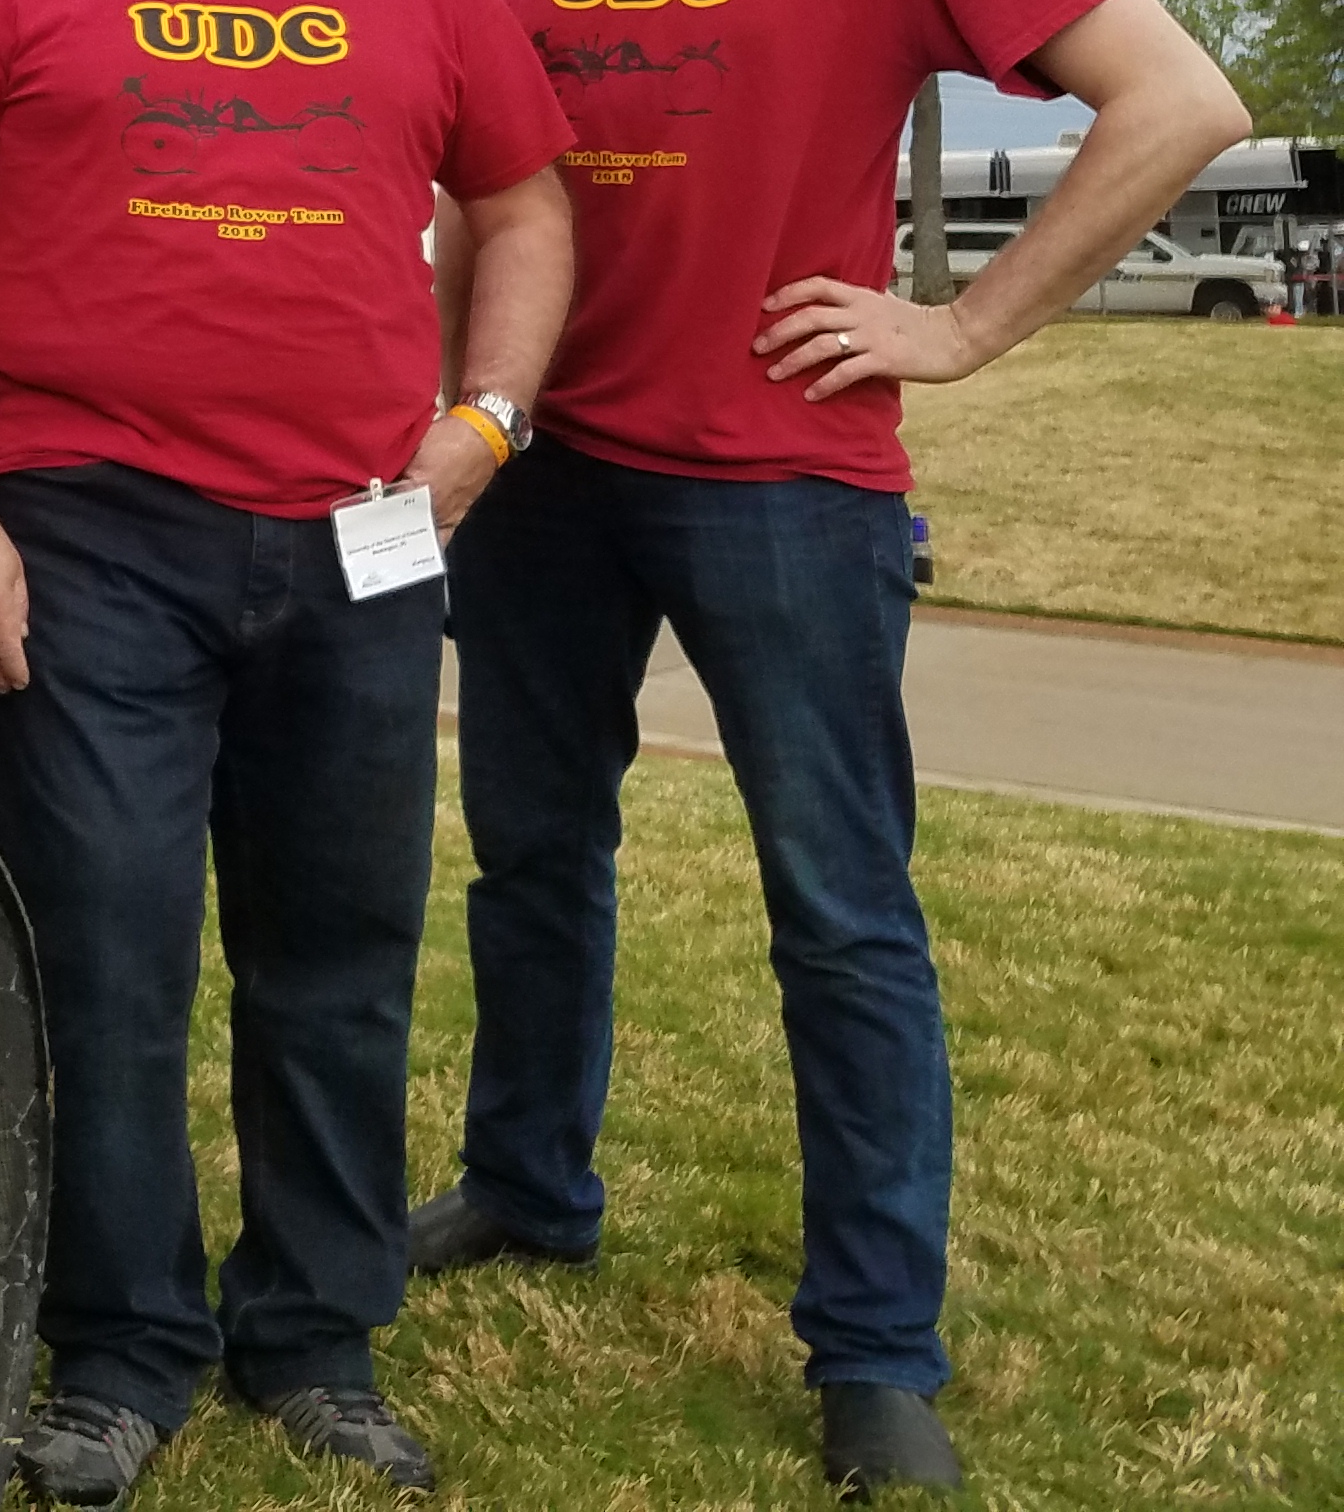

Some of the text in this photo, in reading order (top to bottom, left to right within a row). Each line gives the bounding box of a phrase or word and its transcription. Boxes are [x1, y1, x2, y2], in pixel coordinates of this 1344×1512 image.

[128, 1, 348, 69] UDC
[128, 198, 344, 225] Firebirds Rover Team
[218, 224, 266, 240] 2018
